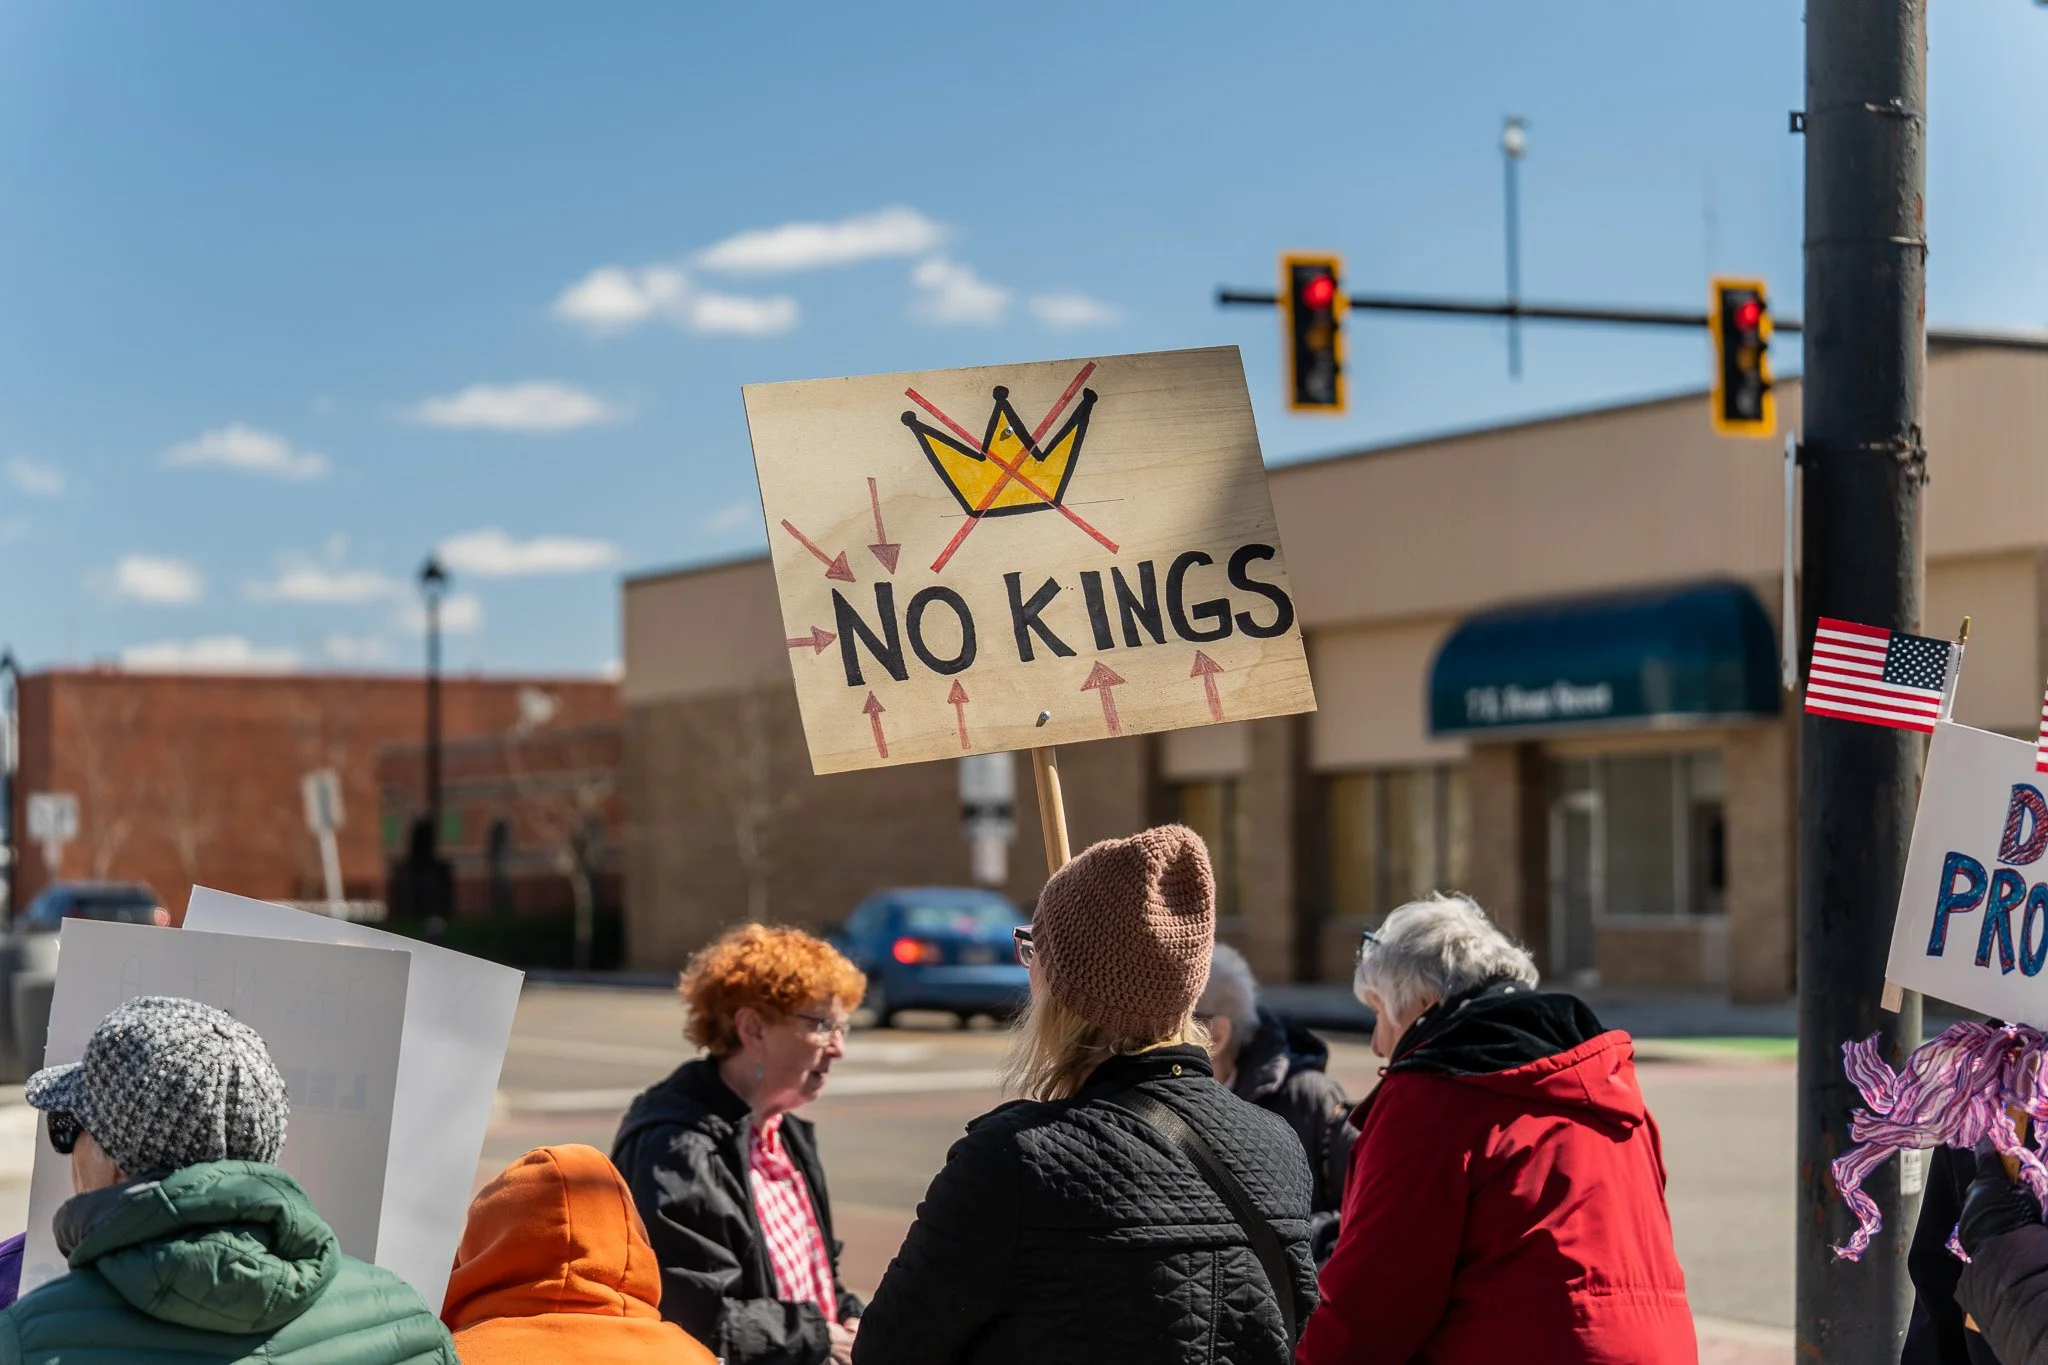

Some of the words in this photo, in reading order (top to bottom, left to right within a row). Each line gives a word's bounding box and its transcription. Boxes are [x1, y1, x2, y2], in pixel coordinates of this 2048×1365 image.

[831, 581, 978, 688] NO
[1002, 543, 1295, 664] KINGS
[1997, 783, 2048, 866] D
[1926, 851, 2048, 978] PRO
